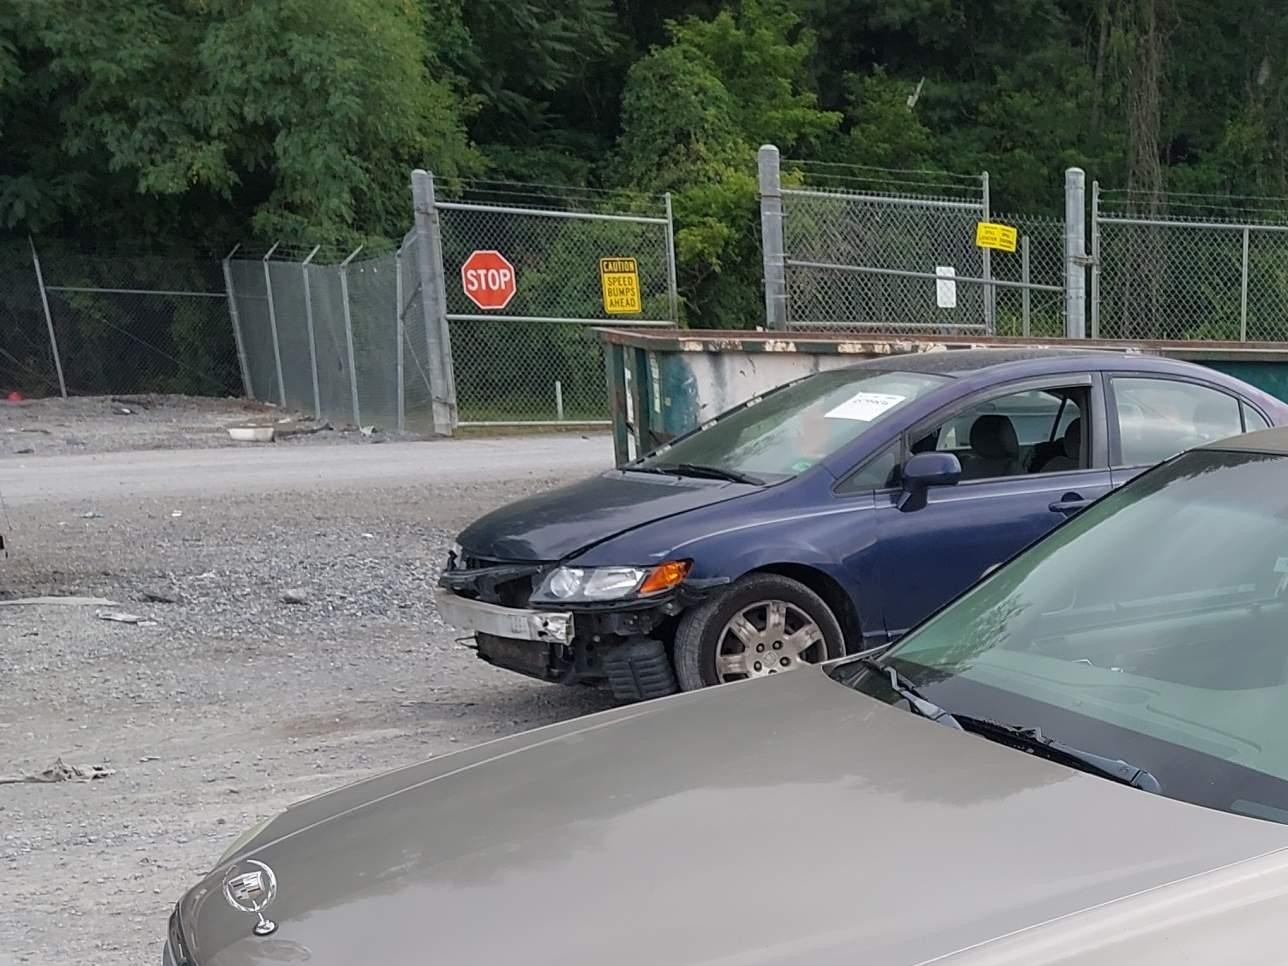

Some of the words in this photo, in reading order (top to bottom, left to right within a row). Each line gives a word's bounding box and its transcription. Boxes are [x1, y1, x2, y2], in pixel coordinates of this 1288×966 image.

[603, 261, 635, 272] CAUTION
[467, 269, 510, 291] STOP
[607, 276, 633, 287] SPEED
[607, 287, 636, 298] BUMPS
[609, 298, 636, 308] AHEAD
